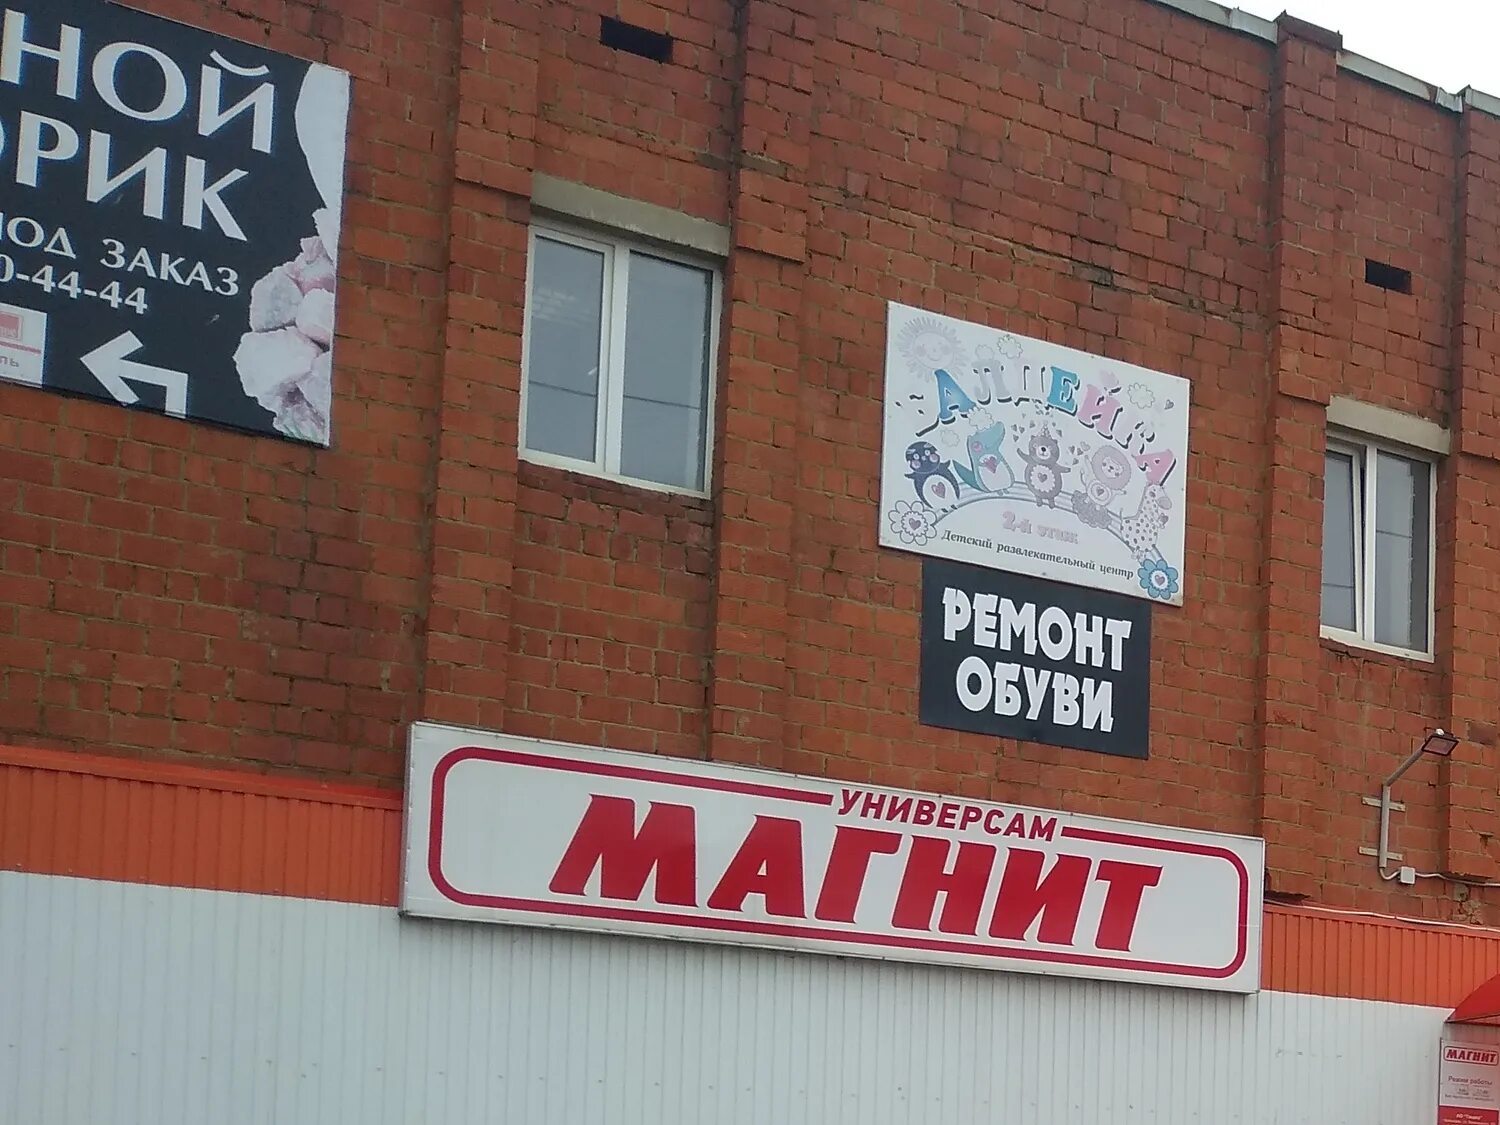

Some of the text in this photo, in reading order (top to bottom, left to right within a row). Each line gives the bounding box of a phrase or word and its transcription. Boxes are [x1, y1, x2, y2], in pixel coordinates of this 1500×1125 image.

[0, 8, 275, 154] НОЙ
[0, 110, 248, 241] РИК
[0, 212, 239, 296] ОД ЗАКАЗ
[941, 529, 1134, 579] Детский развлекательный центр
[941, 587, 1132, 672] РЕМОНТ
[955, 656, 1114, 733] ОБУВИ
[835, 788, 1058, 842] УНИВЕРСАМ
[548, 793, 1163, 952] МАГНИТ
[1447, 1049, 1497, 1063] МАГНИТ
